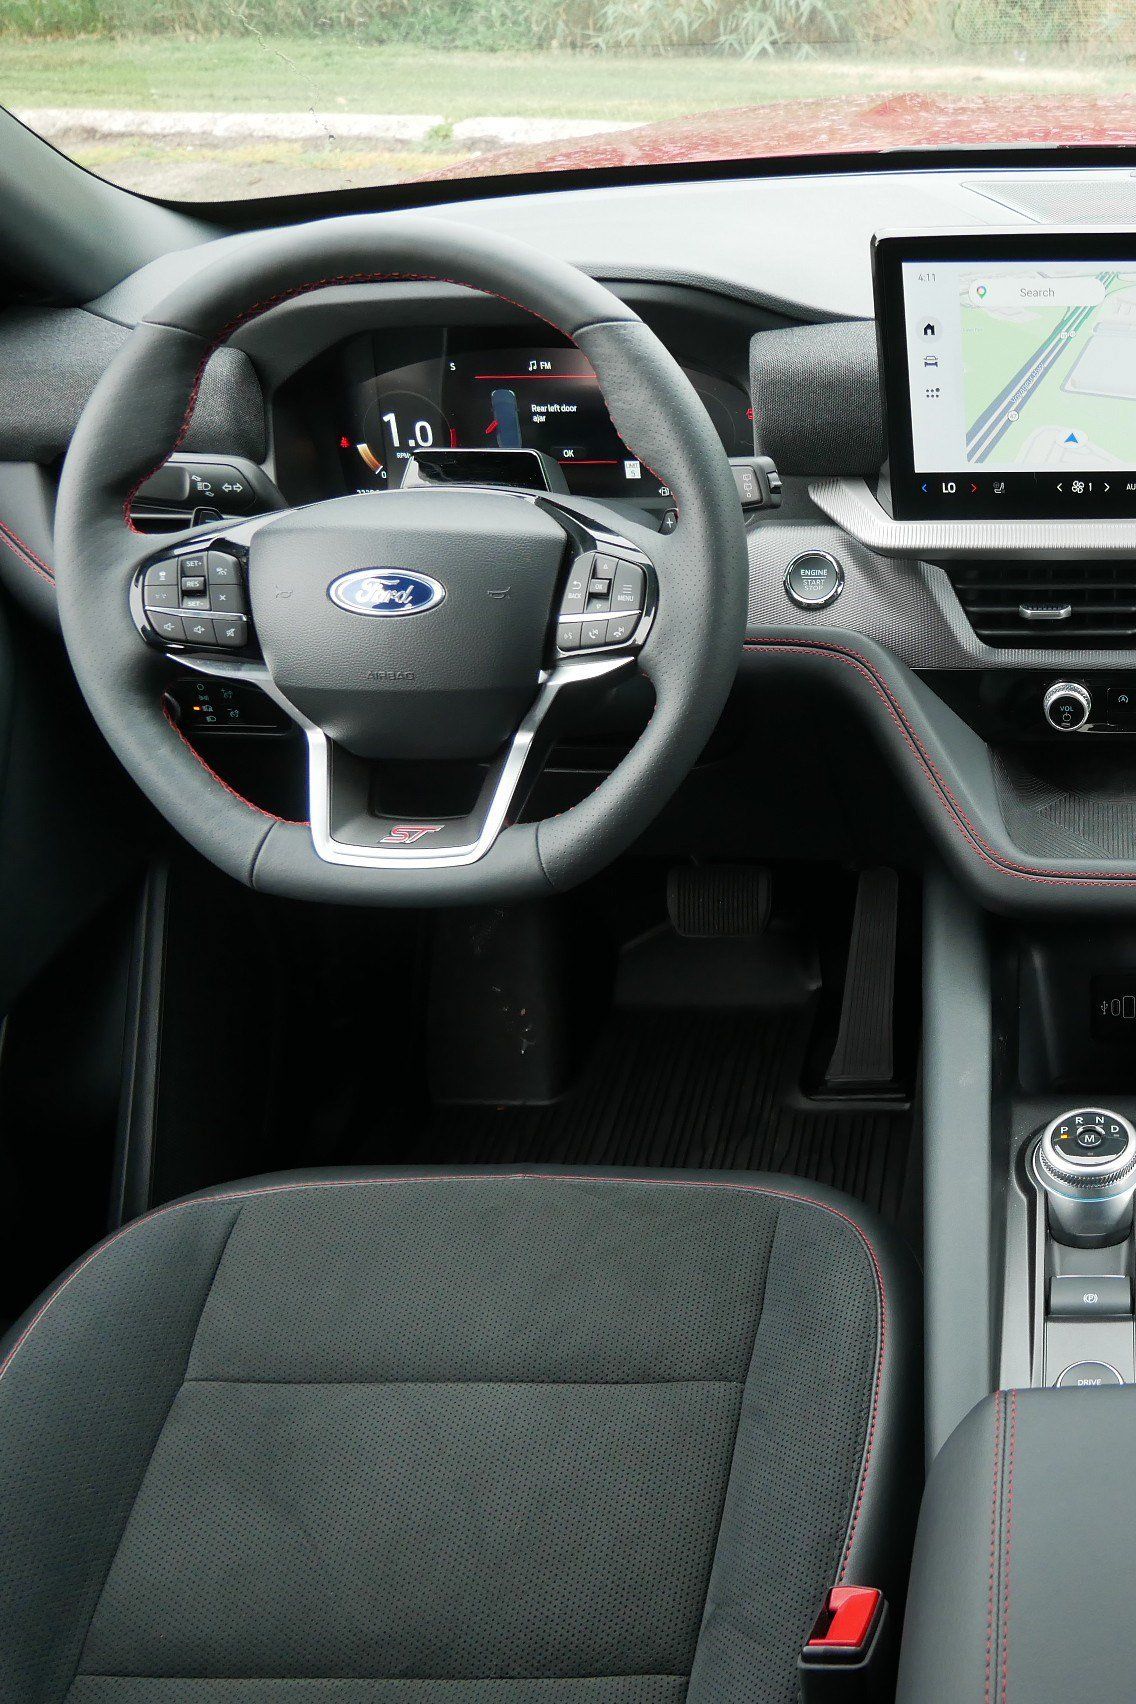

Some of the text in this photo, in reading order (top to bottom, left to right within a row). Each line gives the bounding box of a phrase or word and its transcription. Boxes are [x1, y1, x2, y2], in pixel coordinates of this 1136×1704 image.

[918, 273, 936, 282] 4:11
[1020, 287, 1055, 298] Search
[540, 361, 552, 370] FM
[548, 404, 561, 413] left
[533, 415, 546, 423] ajar
[383, 412, 433, 447] 1.0
[563, 450, 575, 458] OK
[381, 471, 387, 479] 0
[942, 482, 956, 493] LO
[186, 580, 200, 588] RES
[356, 577, 414, 607] Ford
[617, 594, 634, 602] MENU
[379, 824, 446, 844] ST
[1075, 1116, 1105, 1125] R N
[1060, 1125, 1120, 1134] P D
[1084, 1133, 1095, 1143] M
[1077, 1378, 1102, 1386] DRIVE
